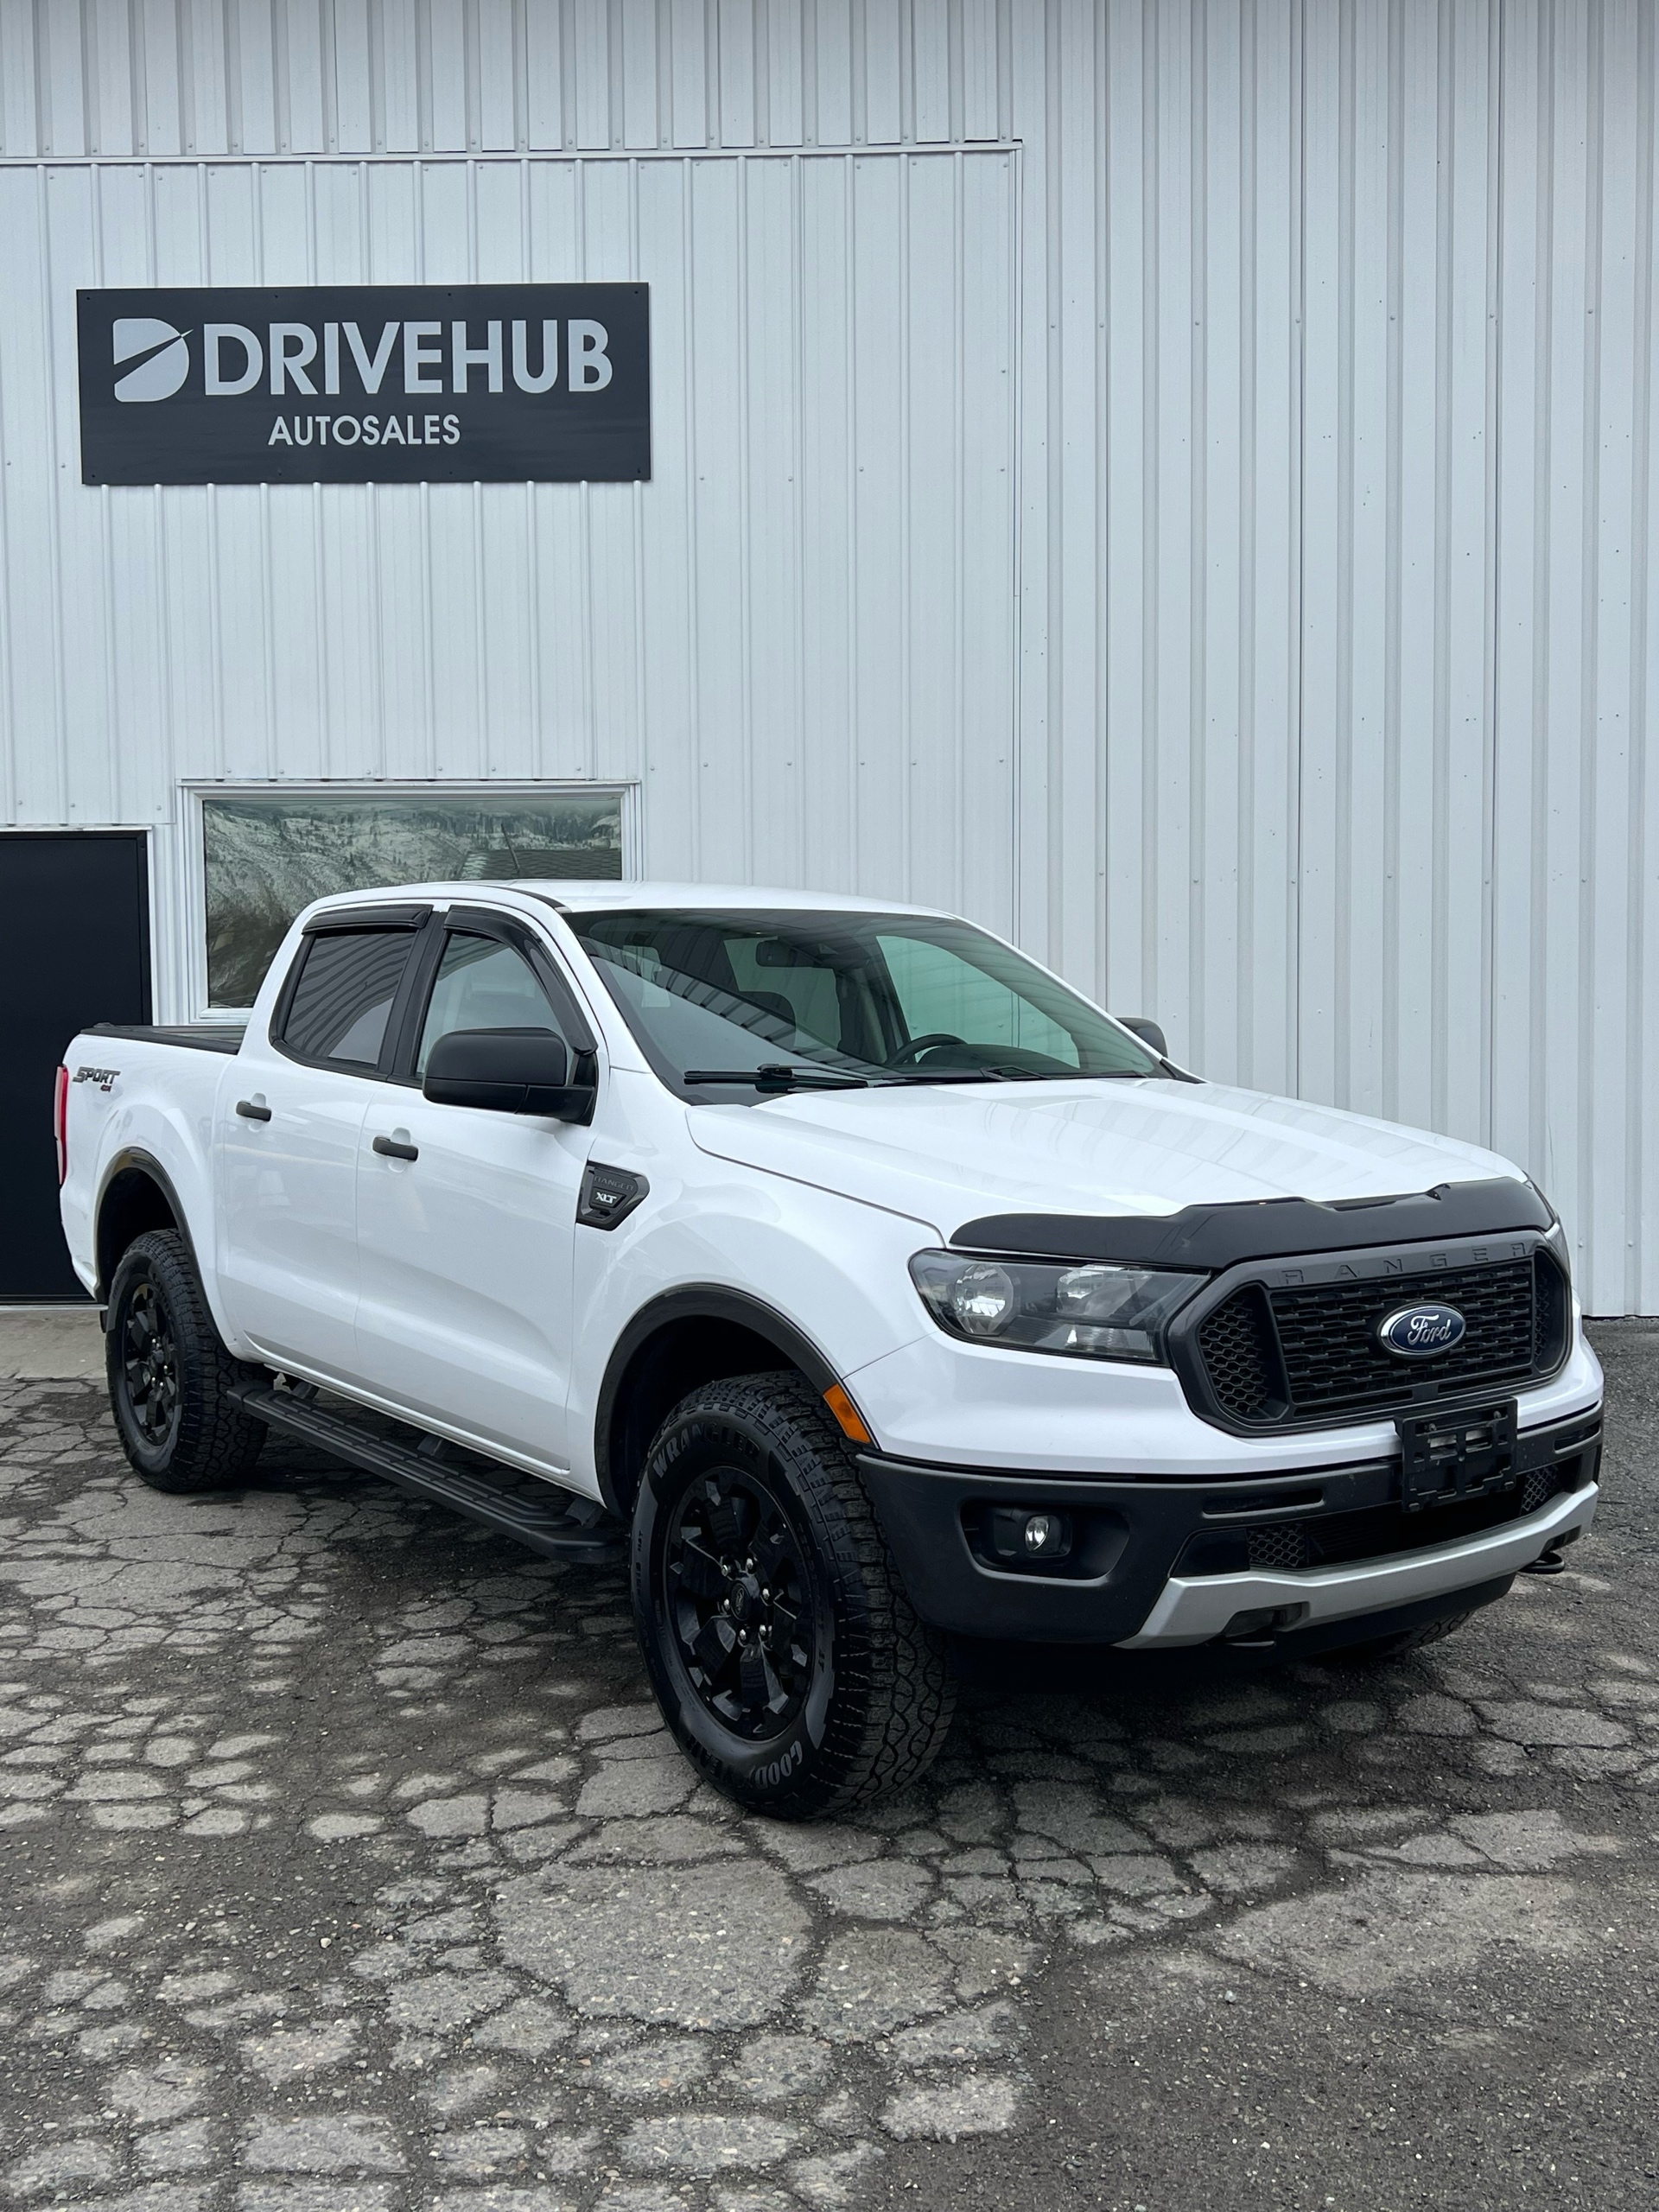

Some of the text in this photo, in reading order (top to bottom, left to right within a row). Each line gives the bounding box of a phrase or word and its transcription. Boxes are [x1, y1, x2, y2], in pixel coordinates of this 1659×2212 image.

[203, 318, 613, 397] DRIVEHUB
[268, 414, 461, 446] AUTOSALES
[73, 1066, 121, 1084] SPORT
[594, 1176, 634, 1192] RANGER
[595, 1192, 618, 1204] XLT
[1281, 1242, 1527, 1285] RANGER
[1408, 1314, 1452, 1345] Ford
[652, 1421, 760, 1479] WRANGLER
